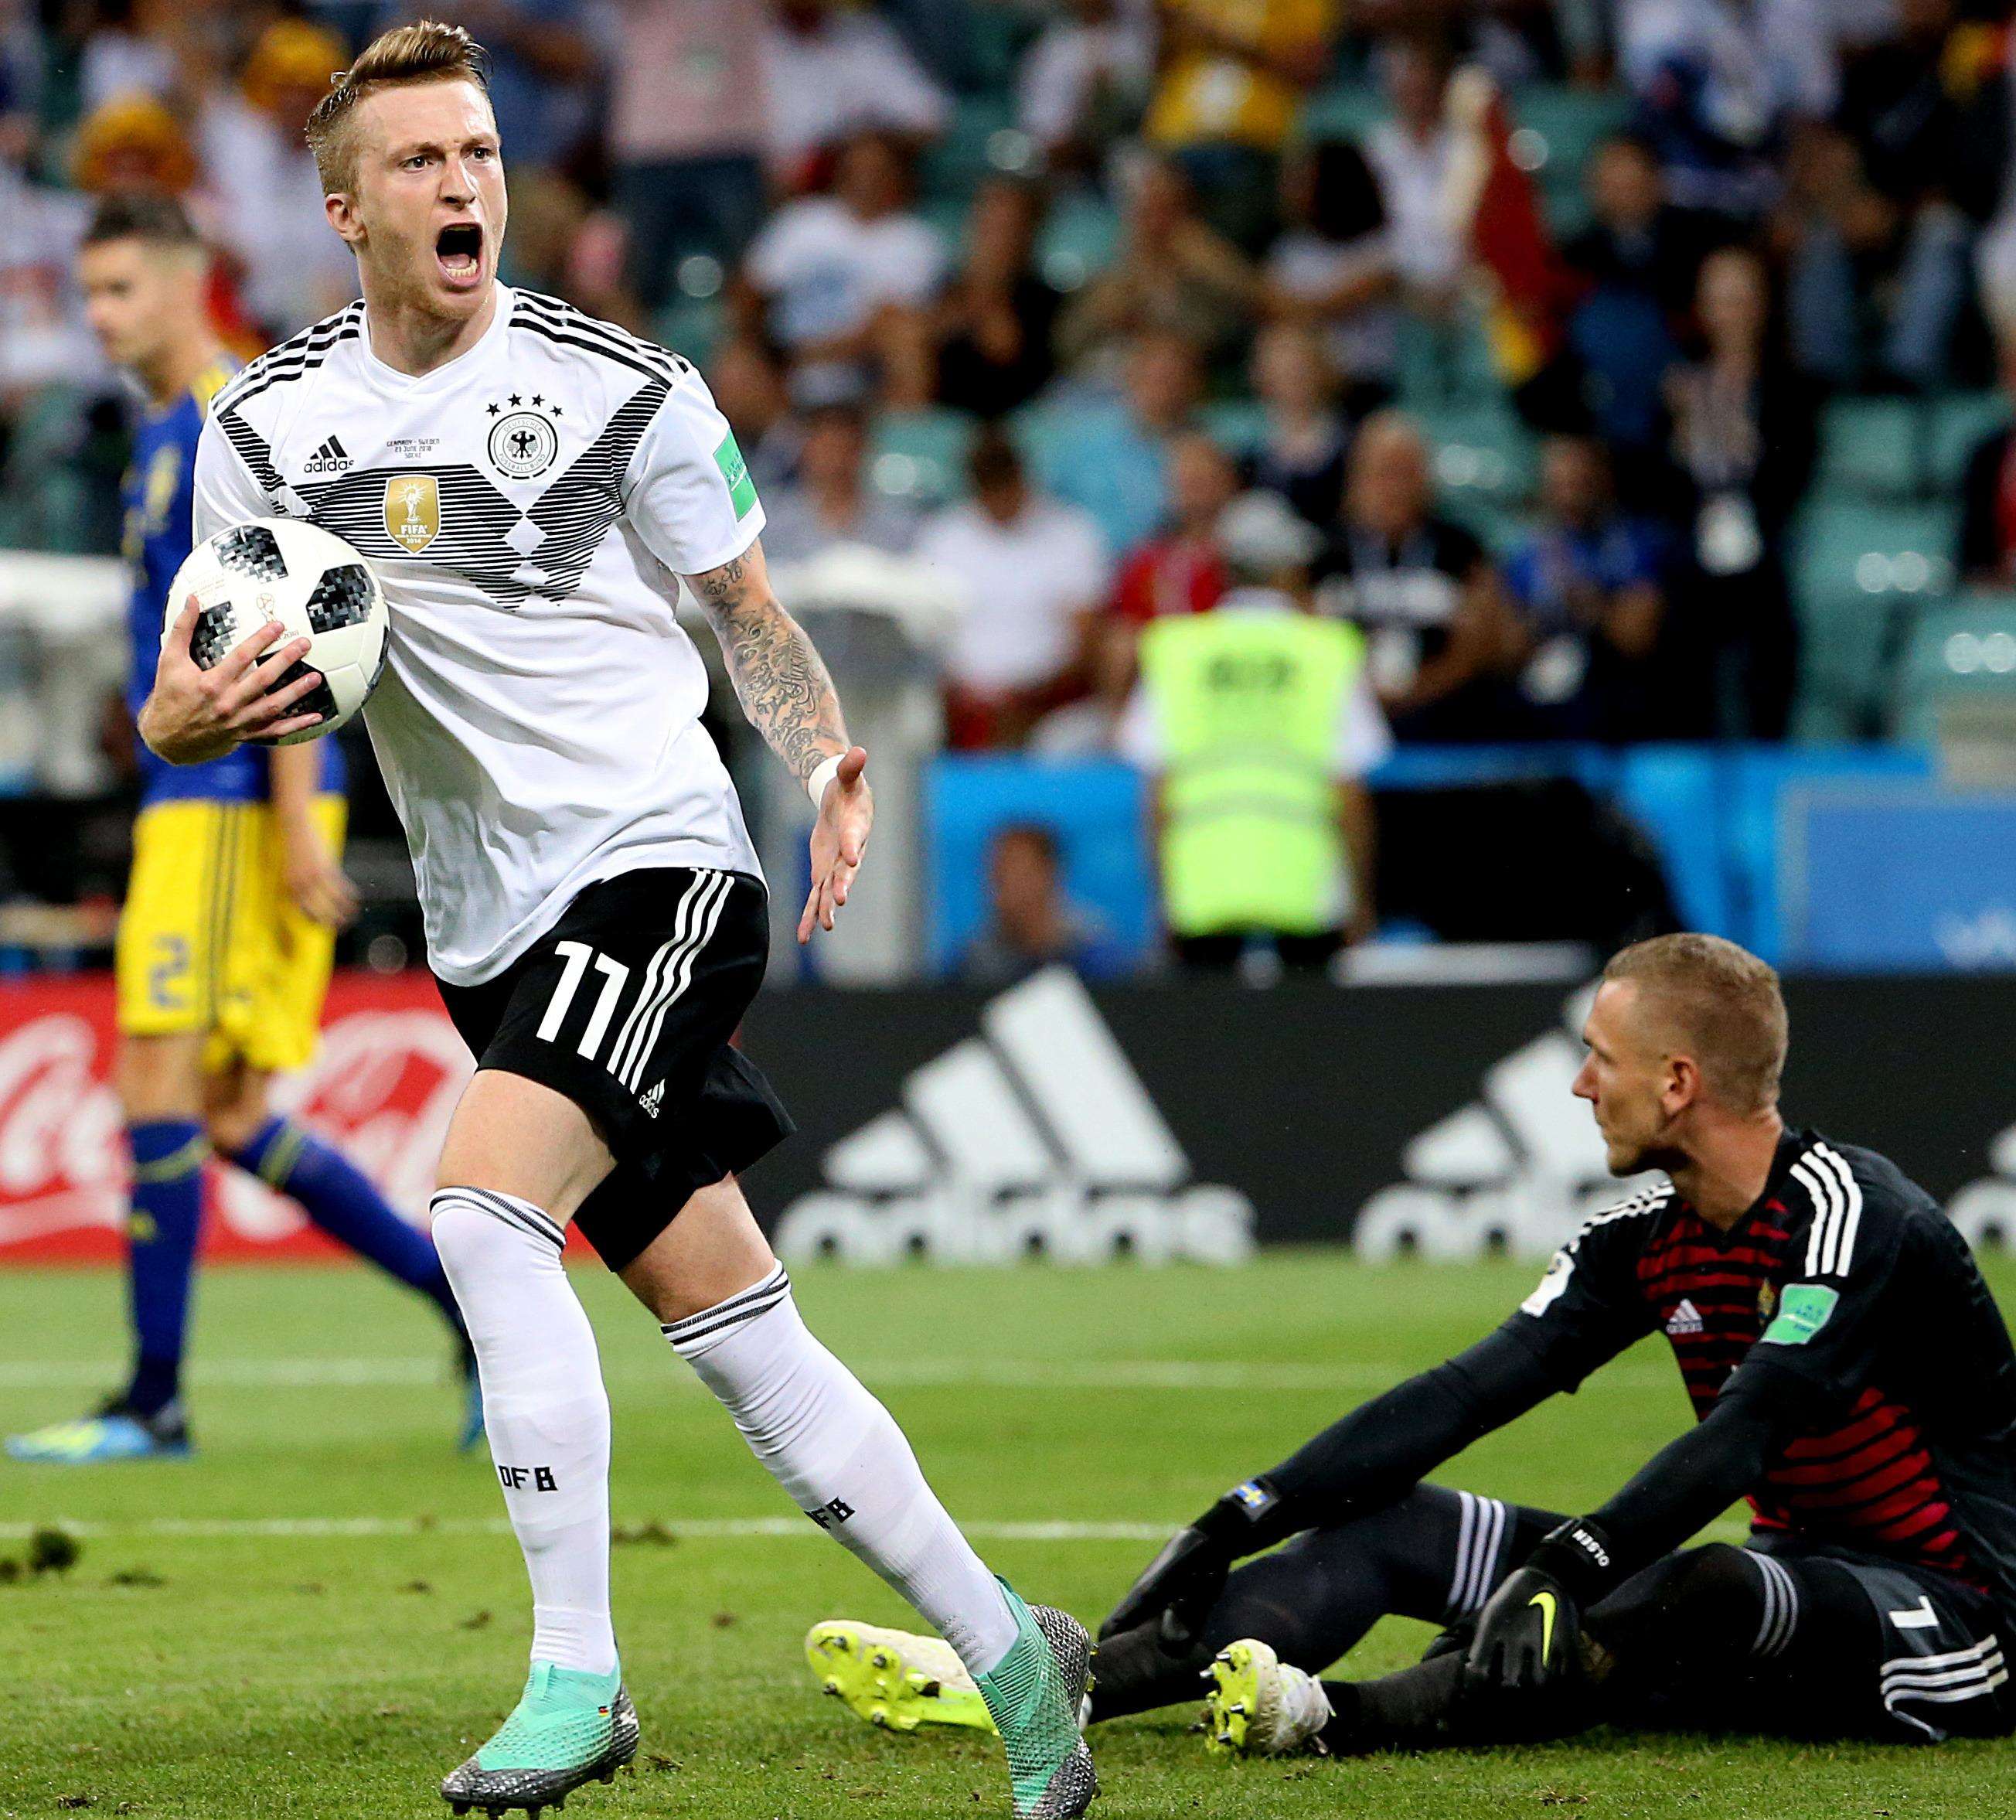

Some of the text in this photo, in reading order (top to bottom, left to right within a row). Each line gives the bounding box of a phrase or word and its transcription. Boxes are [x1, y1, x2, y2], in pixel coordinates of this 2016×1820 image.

[304, 458, 355, 474] adidas
[400, 524, 427, 534] FIFA
[148, 933, 191, 1009] 2
[536, 940, 630, 1061] 11
[498, 1465, 558, 1491] DFB
[1572, 1529, 1610, 1567] OLSEN
[1888, 1594, 1940, 1629] 1
